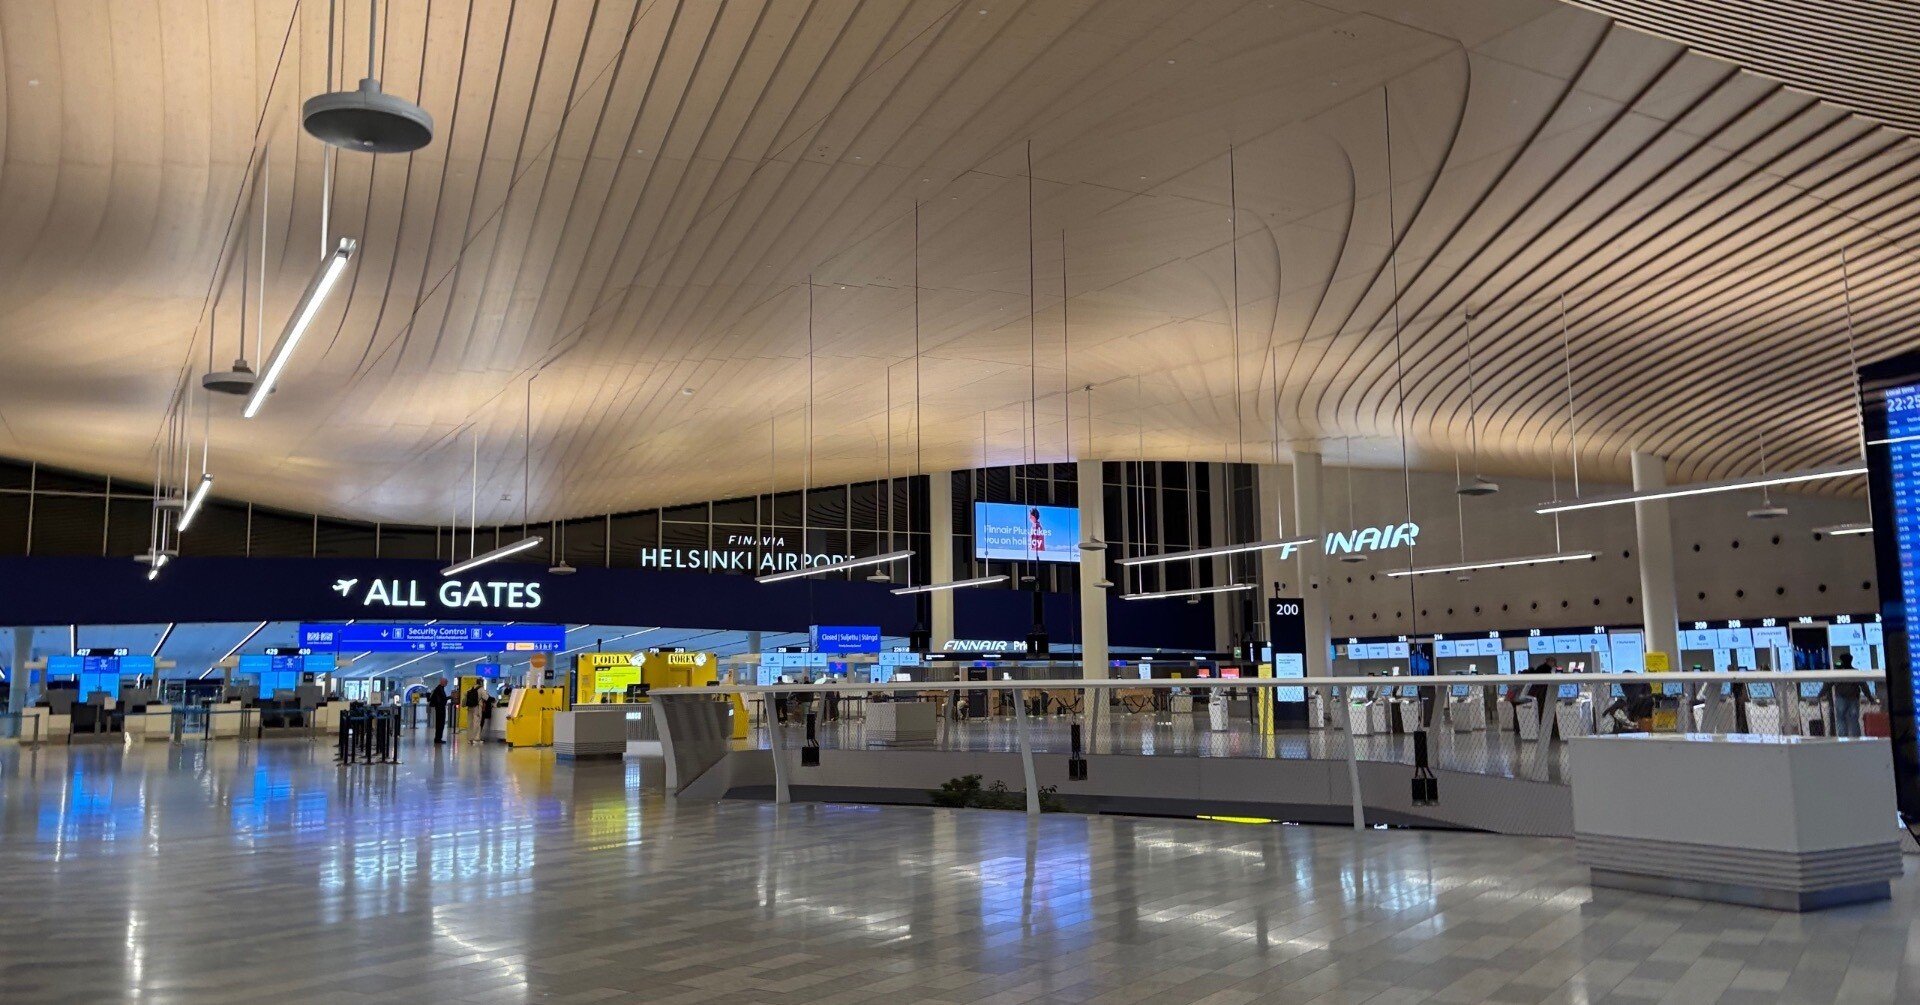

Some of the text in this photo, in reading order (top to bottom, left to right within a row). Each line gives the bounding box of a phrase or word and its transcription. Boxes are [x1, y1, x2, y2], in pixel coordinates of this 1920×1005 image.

[1887, 395, 1920, 413] 22:25
[984, 524, 1012, 534] Finnair
[984, 537, 1000, 546] you
[641, 547, 752, 570] HELSINKI
[363, 578, 542, 608] ALL GATES
[1276, 603, 1299, 616] 200
[1762, 617, 1776, 627] 207
[1836, 614, 1851, 624] 205
[408, 628, 466, 637] Security Control
[821, 633, 838, 641] Closed
[943, 640, 1008, 651] FINNAIR
[77, 648, 91, 656] 427
[113, 648, 128, 656] 428
[593, 654, 631, 666] FOREX
[668, 653, 696, 665] FOREX
